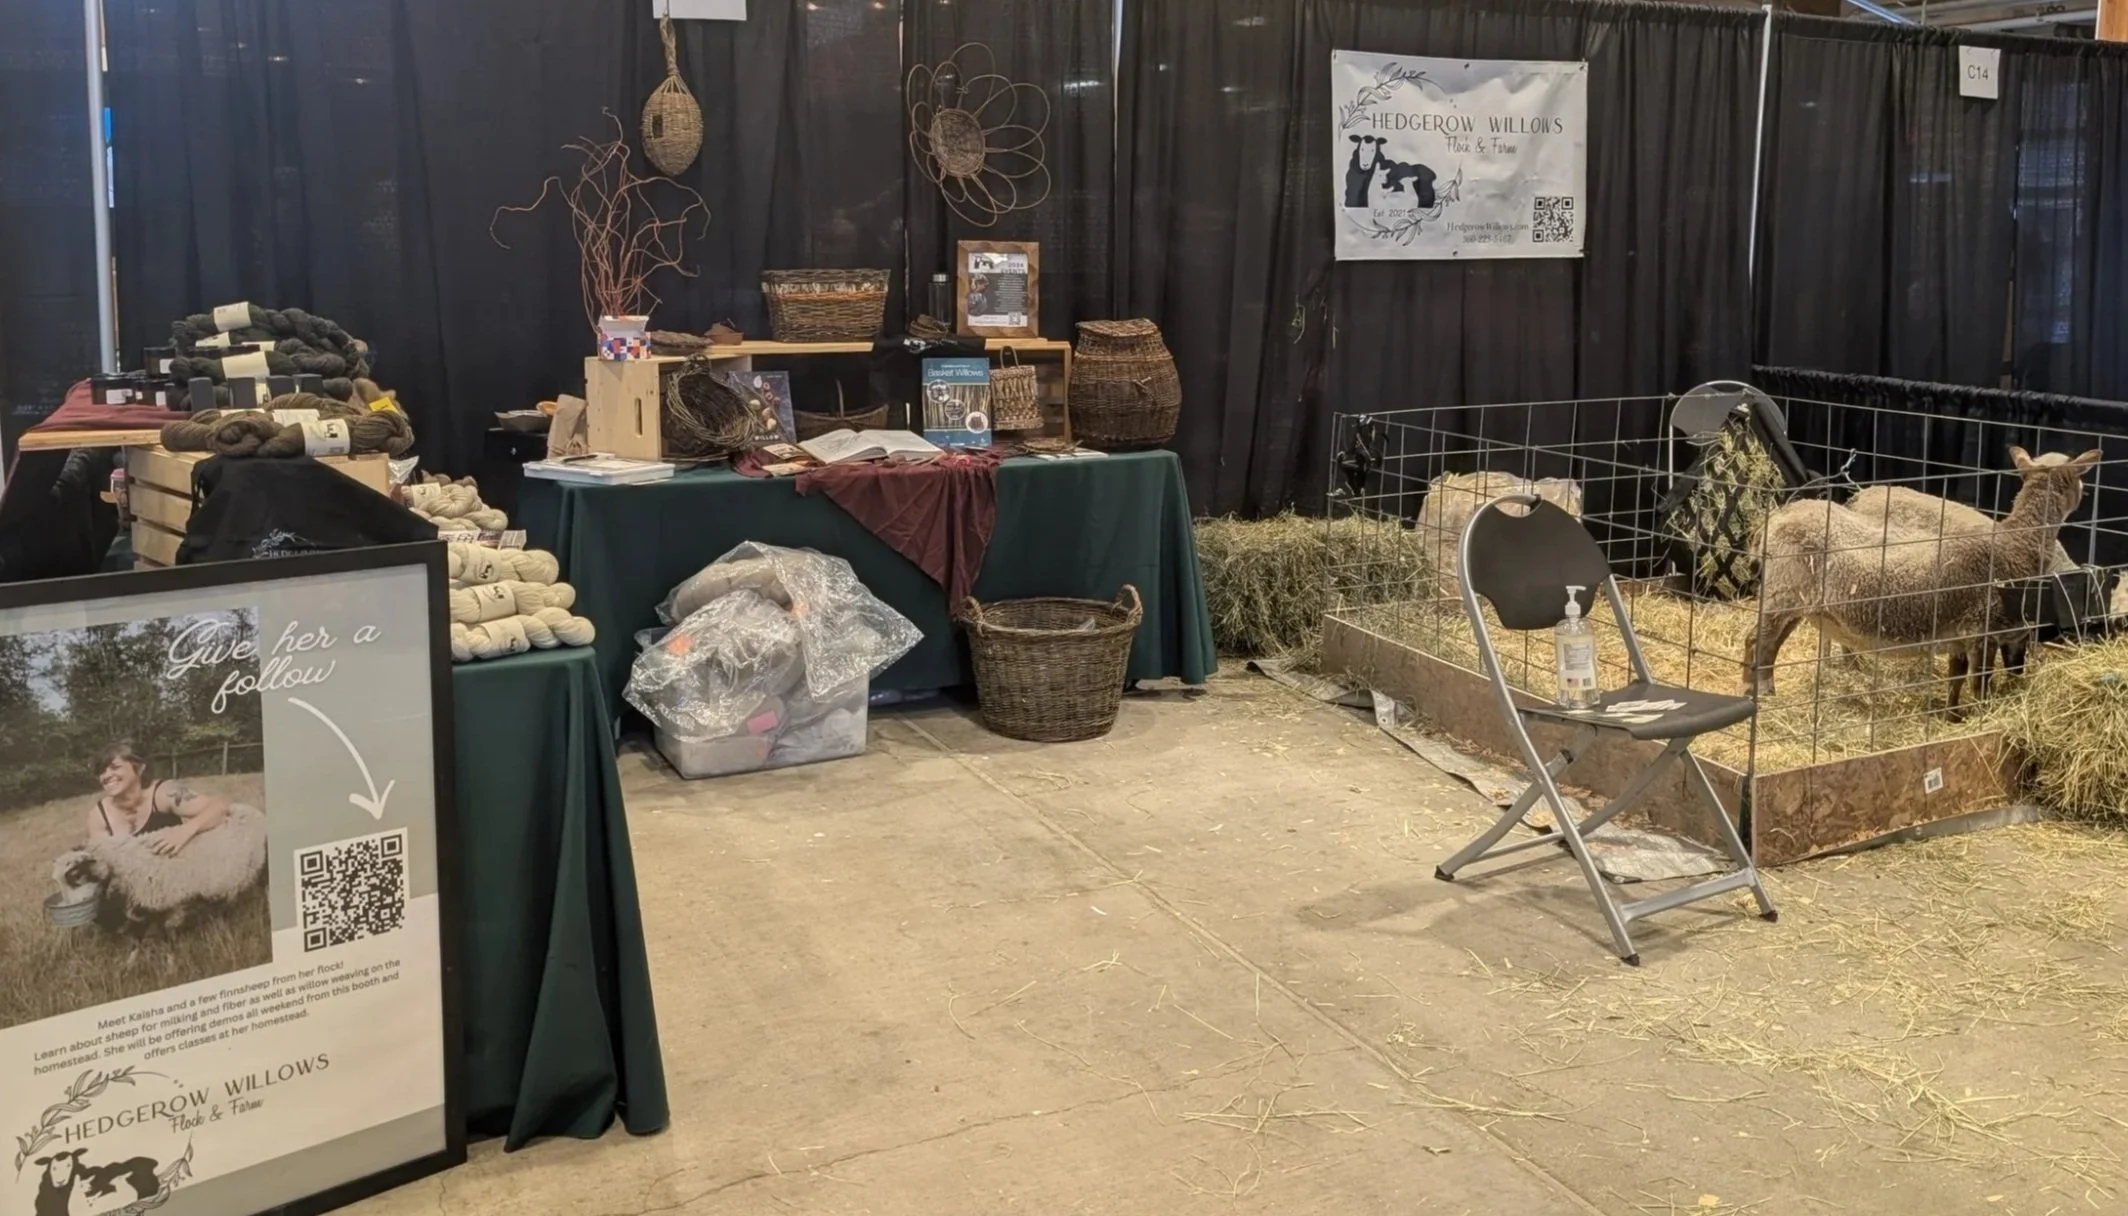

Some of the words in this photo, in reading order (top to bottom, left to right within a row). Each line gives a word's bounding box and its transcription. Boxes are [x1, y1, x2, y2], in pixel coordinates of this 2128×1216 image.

[1968, 64, 1988, 80] C14
[1372, 113, 1476, 136] HEDGEROW
[1489, 116, 1564, 134] WILLOWS
[1444, 136, 1471, 153] Flock
[1476, 136, 1486, 151] &
[1490, 137, 1518, 154] Farm
[927, 368, 954, 377] Basket
[955, 368, 984, 377] Willows
[166, 618, 257, 680] Give
[272, 620, 338, 656] her
[353, 624, 382, 644] a
[211, 655, 336, 714] follow
[34, 1046, 67, 1062] Learn
[69, 1036, 102, 1052] about
[105, 1027, 140, 1043] sheep
[142, 1021, 158, 1033] for
[160, 1011, 198, 1028] milking
[200, 1004, 220, 1018] and
[222, 1000, 246, 1012] fiber
[249, 996, 260, 1005] as
[263, 989, 283, 1002] well
[285, 987, 296, 996] as
[298, 978, 329, 992] willow
[331, 968, 370, 984] weaving
[372, 965, 384, 974] on
[385, 959, 400, 970] the
[98, 1016, 126, 1030] Meet
[128, 1006, 164, 1023] Kaisha
[166, 1000, 188, 1014] and
[190, 999, 196, 1008] a
[198, 994, 217, 1006] few
[220, 980, 270, 1000] finnsheep
[272, 973, 296, 988] from
[298, 968, 316, 979] her
[317, 960, 344, 974] flock!
[34, 1050, 102, 1076] homestead.
[104, 1044, 125, 1058] She
[127, 1038, 146, 1051] will
[148, 1034, 162, 1046] be
[164, 1022, 207, 1042] offering
[209, 1012, 244, 1029] demos
[246, 1008, 259, 1019] all
[260, 996, 304, 1015] weekend
[306, 991, 330, 1004] from
[332, 984, 350, 997] this
[352, 976, 380, 992] booth
[382, 972, 400, 983] and
[144, 1044, 176, 1060] offers
[178, 1034, 217, 1050] classes
[218, 1030, 230, 1040] at
[232, 1024, 250, 1036] her
[250, 1009, 310, 1032] homestead.
[64, 1087, 210, 1144] HEDGEROW
[224, 1053, 330, 1097] WILLOWS
[168, 1109, 206, 1134] Flock
[210, 1104, 223, 1122] &
[228, 1096, 264, 1116] Farm
